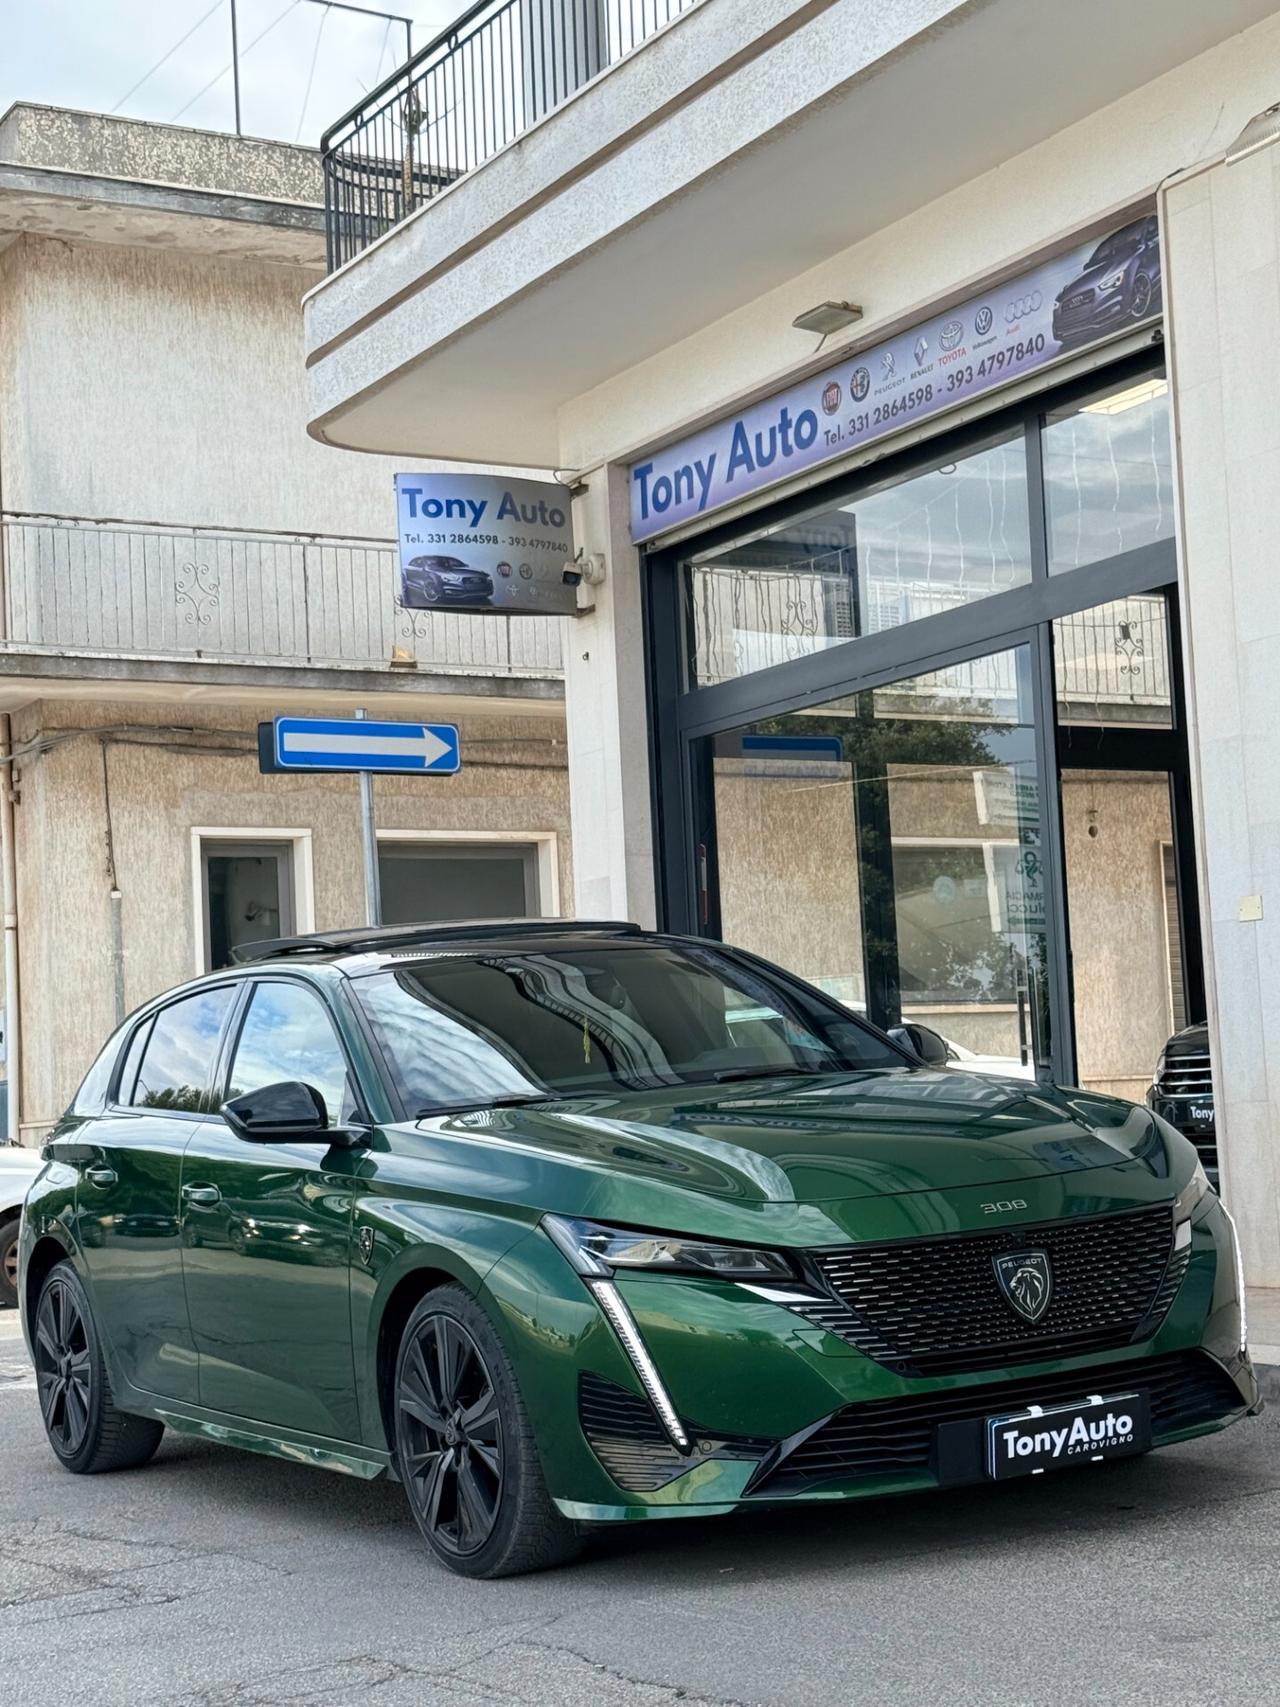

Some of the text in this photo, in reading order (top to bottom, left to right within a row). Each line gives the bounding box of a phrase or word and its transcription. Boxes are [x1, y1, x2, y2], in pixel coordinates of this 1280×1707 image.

[938, 346, 967, 367] TOYOTA
[824, 424, 845, 446] Tel.
[848, 415, 870, 436] 331
[873, 384, 933, 424] 2864598
[946, 366, 974, 393] 393
[977, 333, 1045, 377] 4797840
[874, 377, 906, 396] PEUGEOT
[633, 406, 819, 521] Tony Auto
[402, 488, 566, 528] Tony Auto
[404, 533, 423, 544] Tel.
[427, 533, 446, 544] 331
[451, 533, 499, 545] 2864598
[509, 536, 527, 547] 393
[528, 538, 568, 553] 4797840
[1190, 1106, 1215, 1122] Tony
[980, 1200, 1027, 1214] 308
[1002, 1257, 1042, 1269] PEUGEOT
[1003, 1413, 1133, 1459] TonyAuto
[1067, 1433, 1134, 1456] CAROVIGNO
